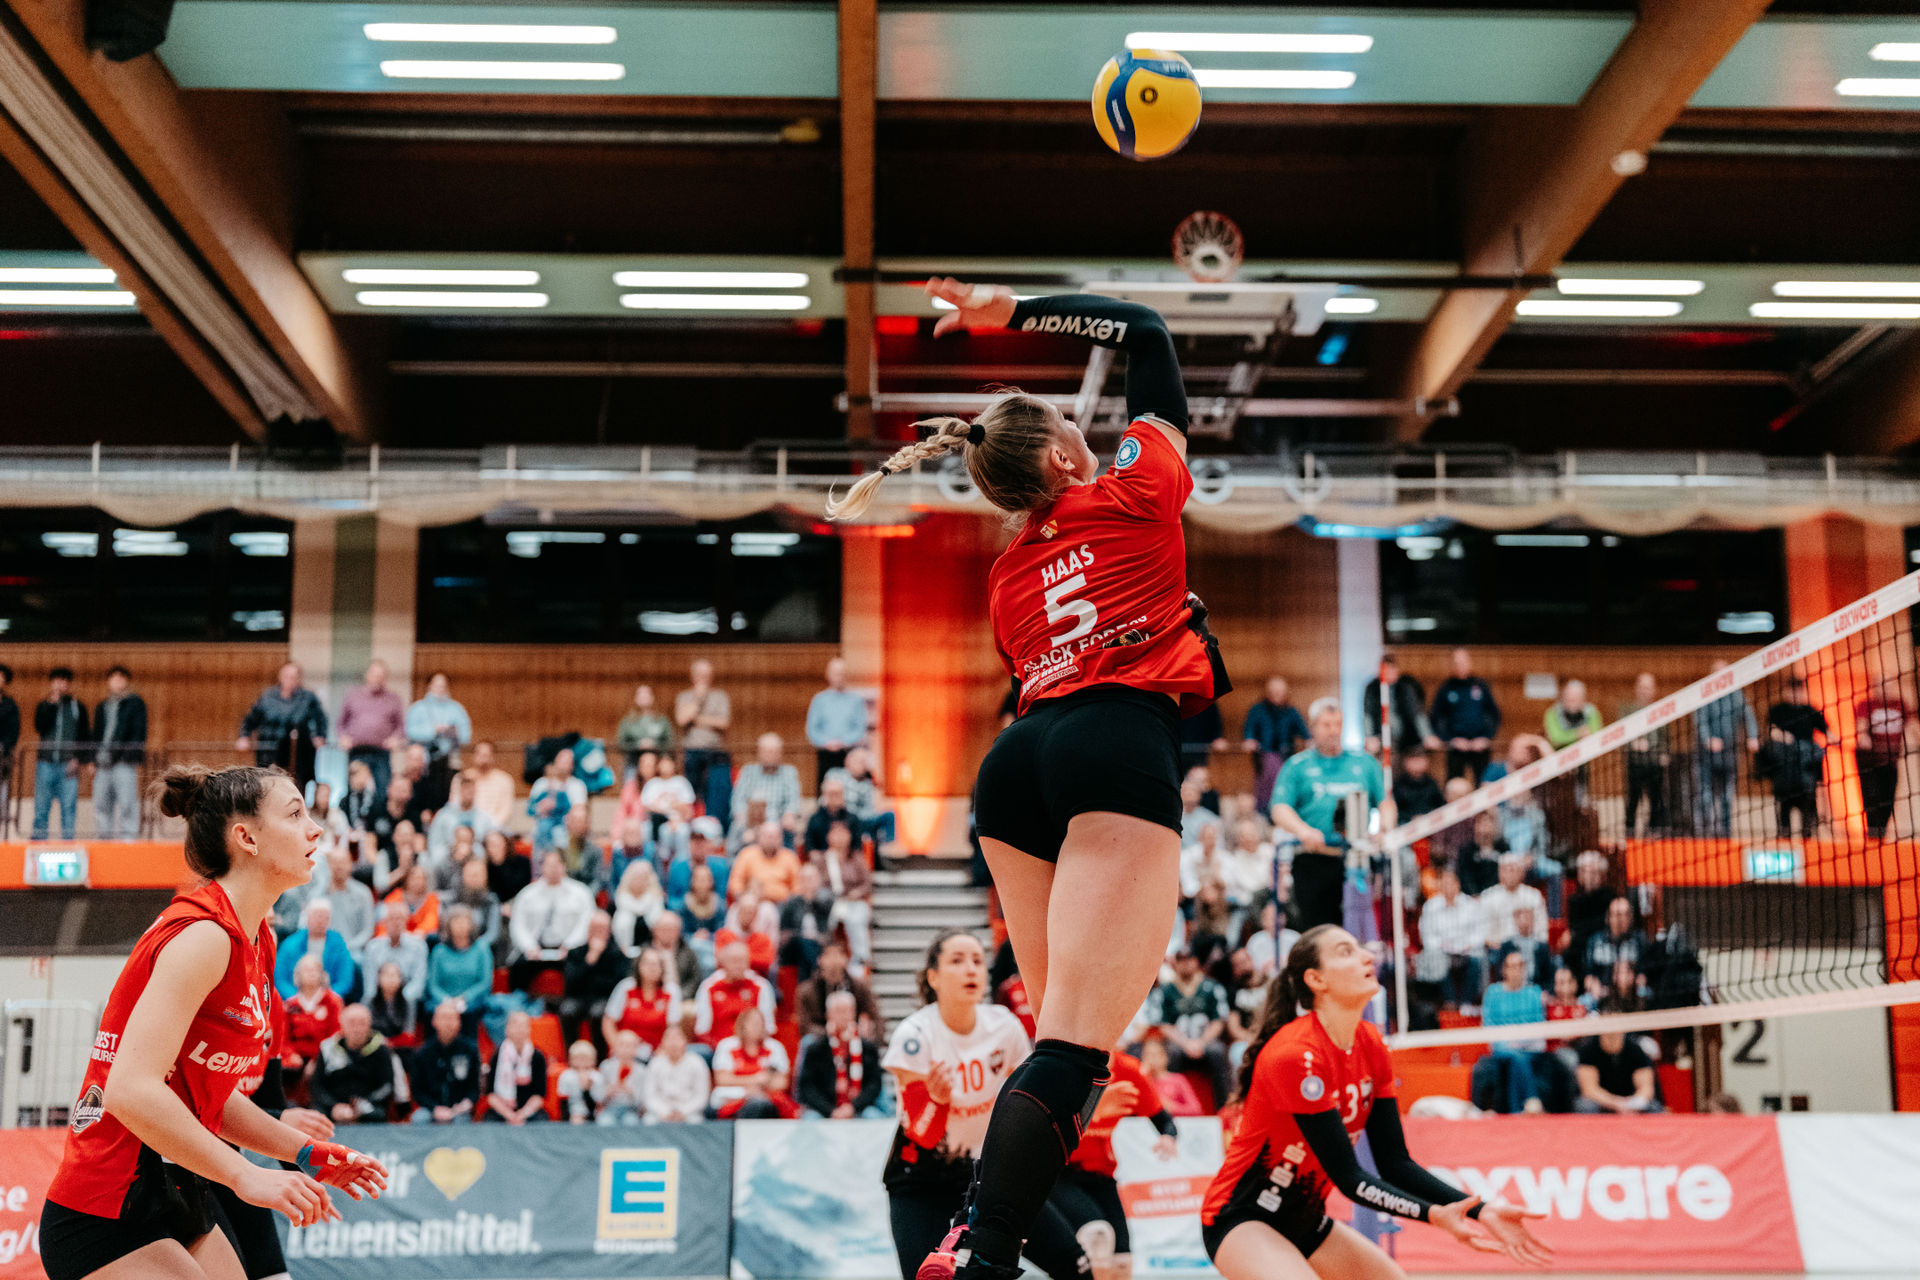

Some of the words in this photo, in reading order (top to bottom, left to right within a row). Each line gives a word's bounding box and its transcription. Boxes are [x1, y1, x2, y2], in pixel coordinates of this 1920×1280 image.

[1021, 314, 1128, 343] Lexware
[1041, 543, 1095, 587] HAAS
[1044, 572, 1099, 648] 5
[1832, 597, 1878, 635] Lexware
[1761, 636, 1800, 669] Lexware
[1732, 1018, 1768, 1066] 2
[957, 1059, 985, 1095] 10
[1341, 1084, 1359, 1125] 3
[610, 1160, 667, 1214] E
[1355, 1180, 1422, 1219] Lexware
